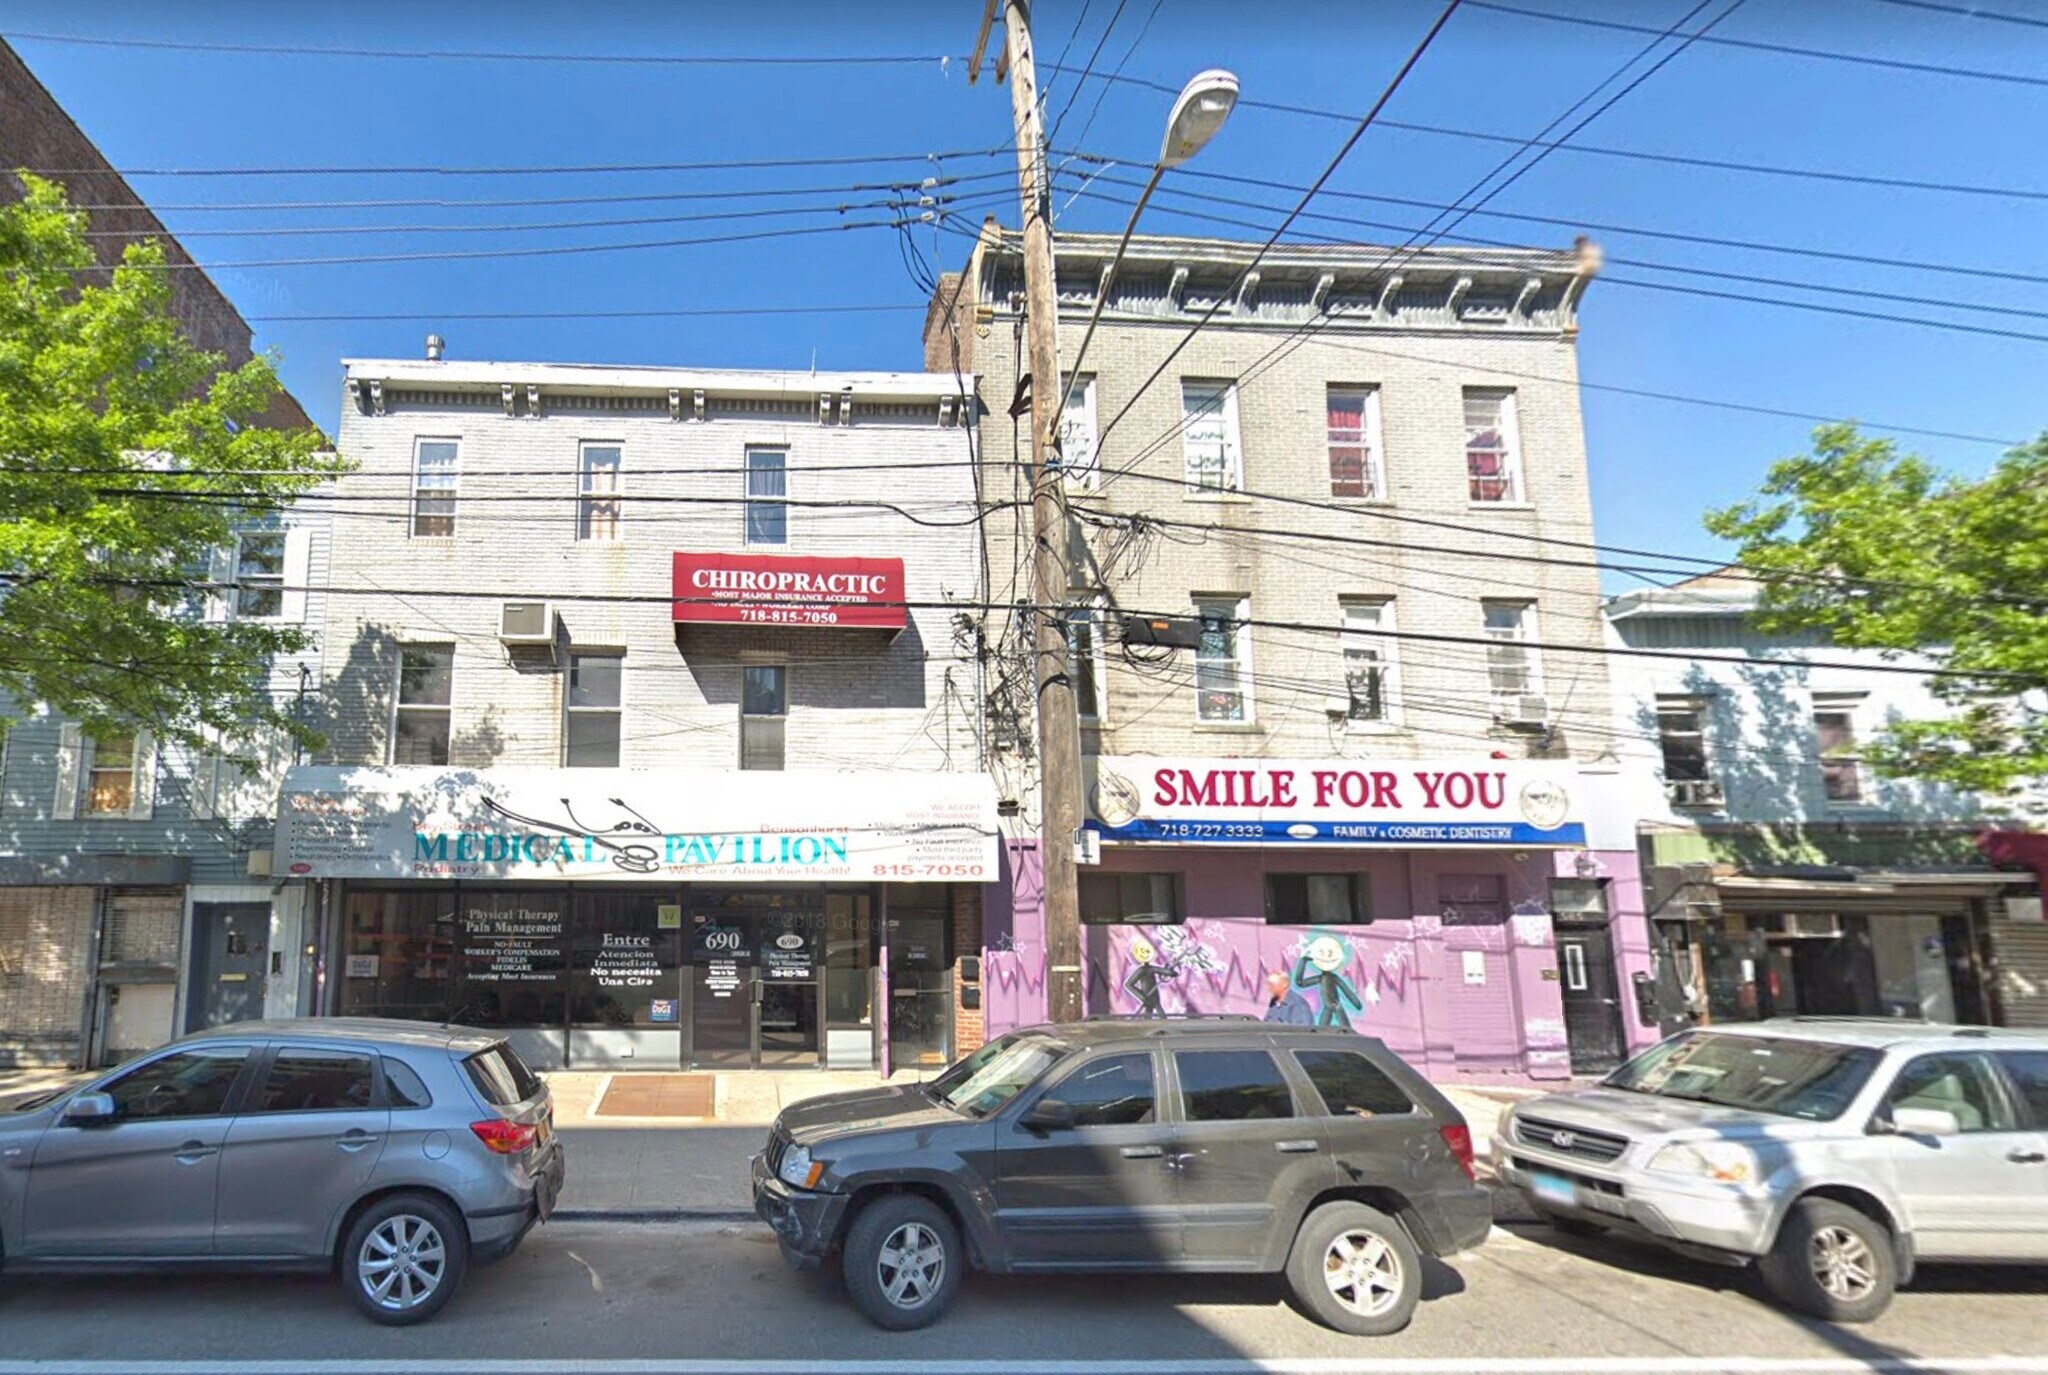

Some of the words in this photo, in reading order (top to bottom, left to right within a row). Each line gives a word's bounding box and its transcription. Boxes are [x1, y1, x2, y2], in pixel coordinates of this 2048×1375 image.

[692, 569, 886, 594] CHIROPRACTIC
[714, 591, 739, 599] MOST
[742, 592, 772, 600] MAJOR
[775, 593, 822, 602] INSURANCE
[825, 595, 868, 604] ACCEPTED
[740, 610, 837, 624] 718-815-7050
[1154, 768, 1298, 807] SMILE
[1312, 770, 1402, 808] FOR
[1413, 771, 1507, 810] YOU
[761, 824, 849, 834] Bensonhurst
[1160, 823, 1264, 837] 718-727-3333
[1333, 825, 1377, 838] FAMILY
[1388, 826, 1448, 839] COSMETIC
[1450, 826, 1513, 840] DENTISTRY
[413, 832, 607, 863] MEDICAL
[663, 835, 848, 864] PAVILION
[413, 863, 480, 875] Podiatry
[669, 866, 690, 875] We
[694, 866, 728, 875] Care
[732, 866, 772, 876] About
[775, 866, 803, 876] Your
[873, 864, 984, 876] 815-7050
[469, 909, 513, 922] Physical
[518, 909, 559, 922] Therapy
[466, 921, 491, 933] Pain
[495, 922, 562, 934] Management
[602, 933, 650, 946] Entre
[705, 932, 740, 950] 690
[598, 950, 654, 959] Atencion
[491, 964, 532, 972] MEDICARE
[594, 959, 658, 967] Inmediata
[590, 967, 609, 976] No
[611, 967, 662, 976] necesita
[598, 977, 624, 986] Una
